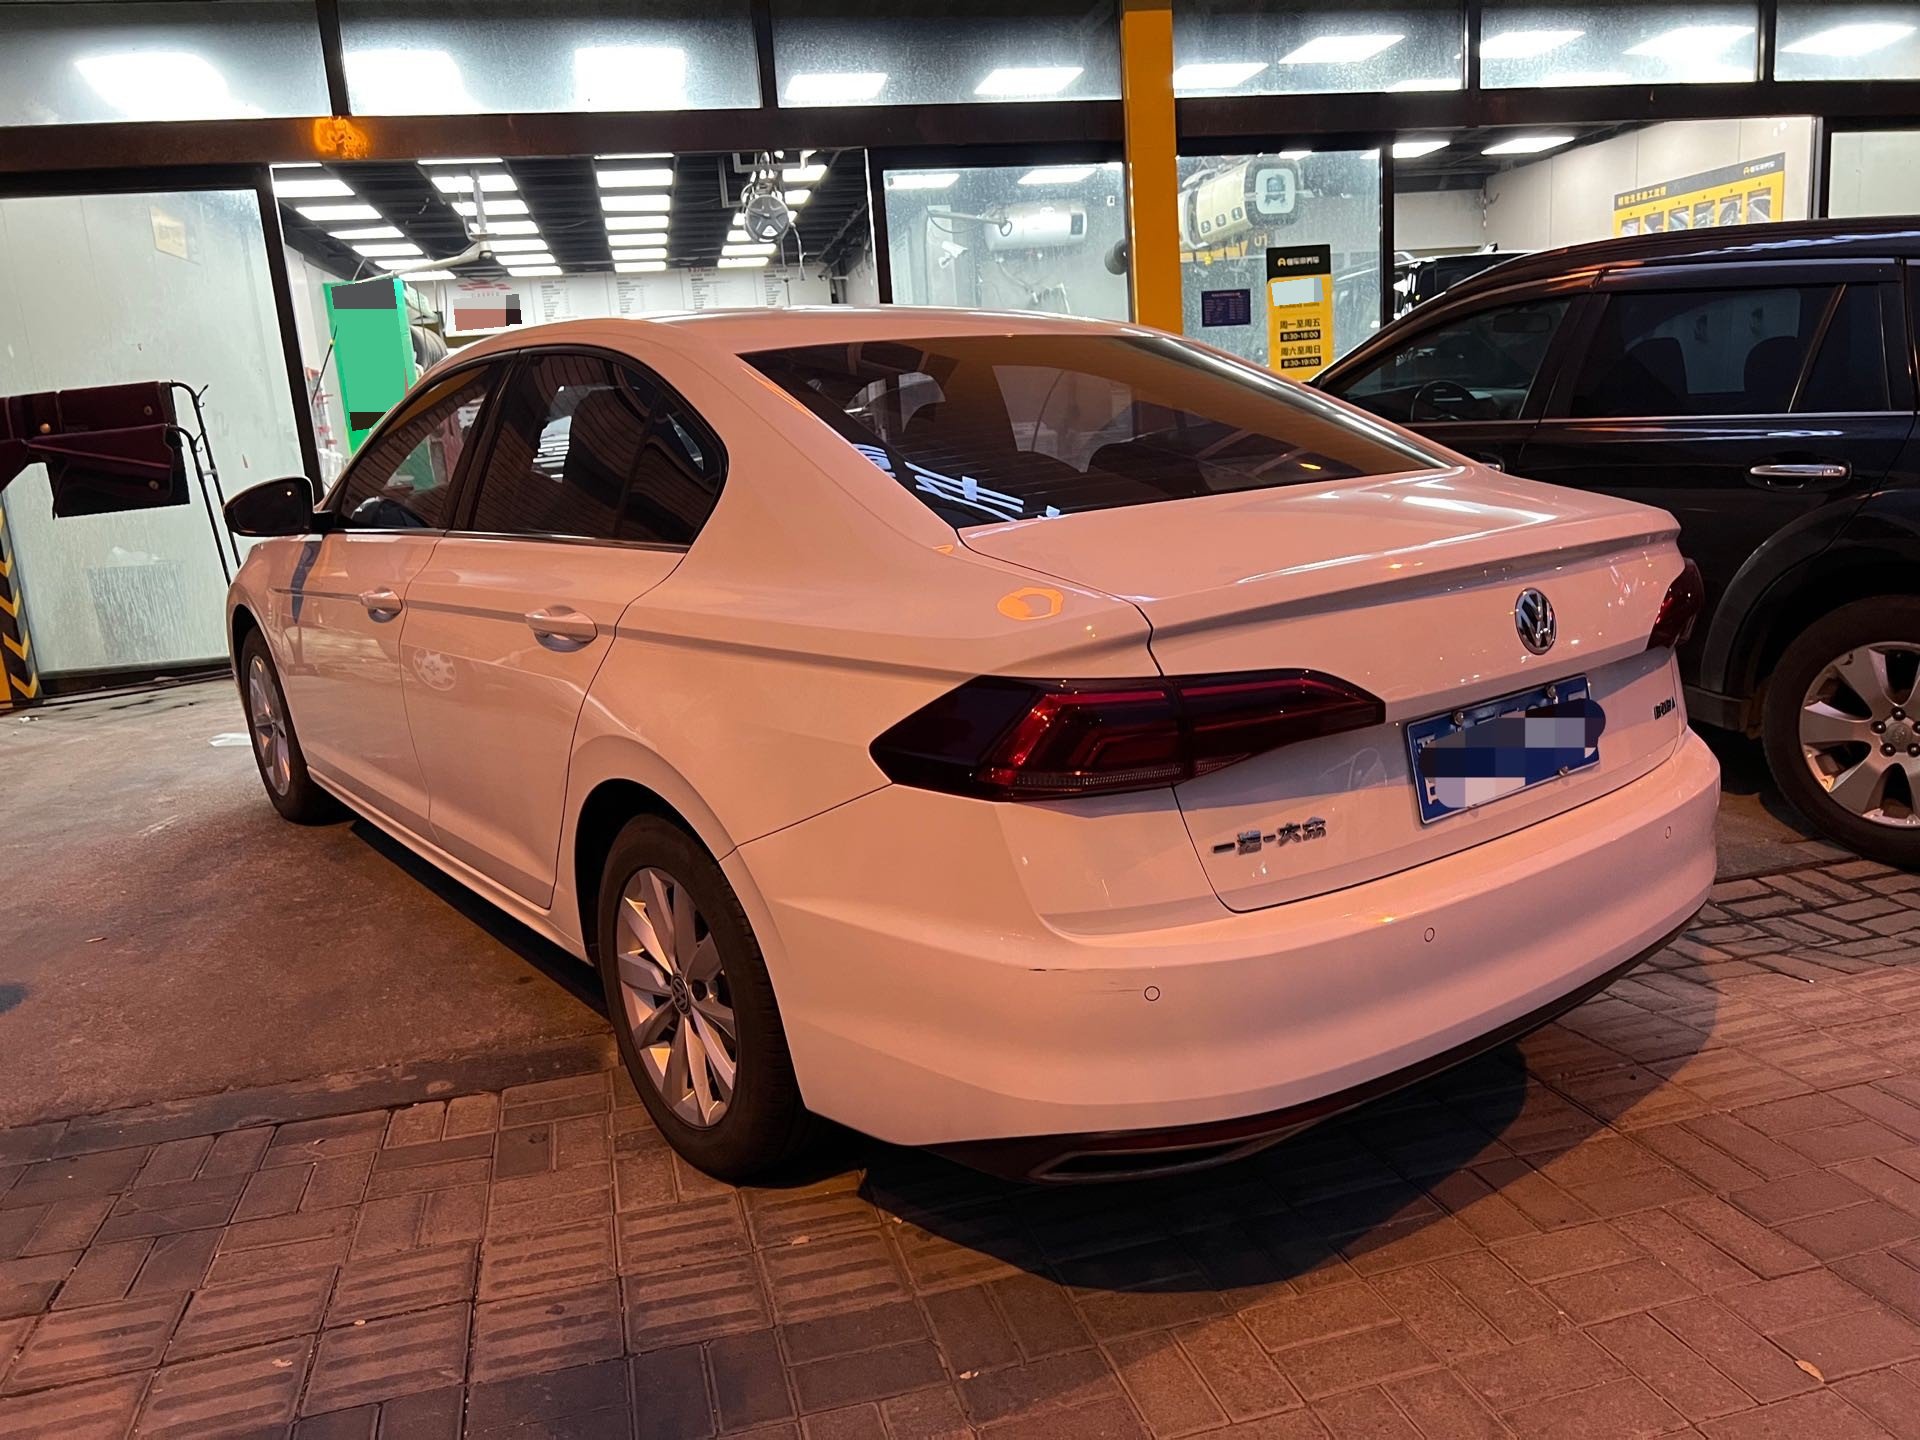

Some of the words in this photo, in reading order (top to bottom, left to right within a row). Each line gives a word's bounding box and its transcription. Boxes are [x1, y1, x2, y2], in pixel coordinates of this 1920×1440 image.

[1280, 318, 1321, 330] 周一至周五
[1280, 345, 1321, 357] 周六至周日
